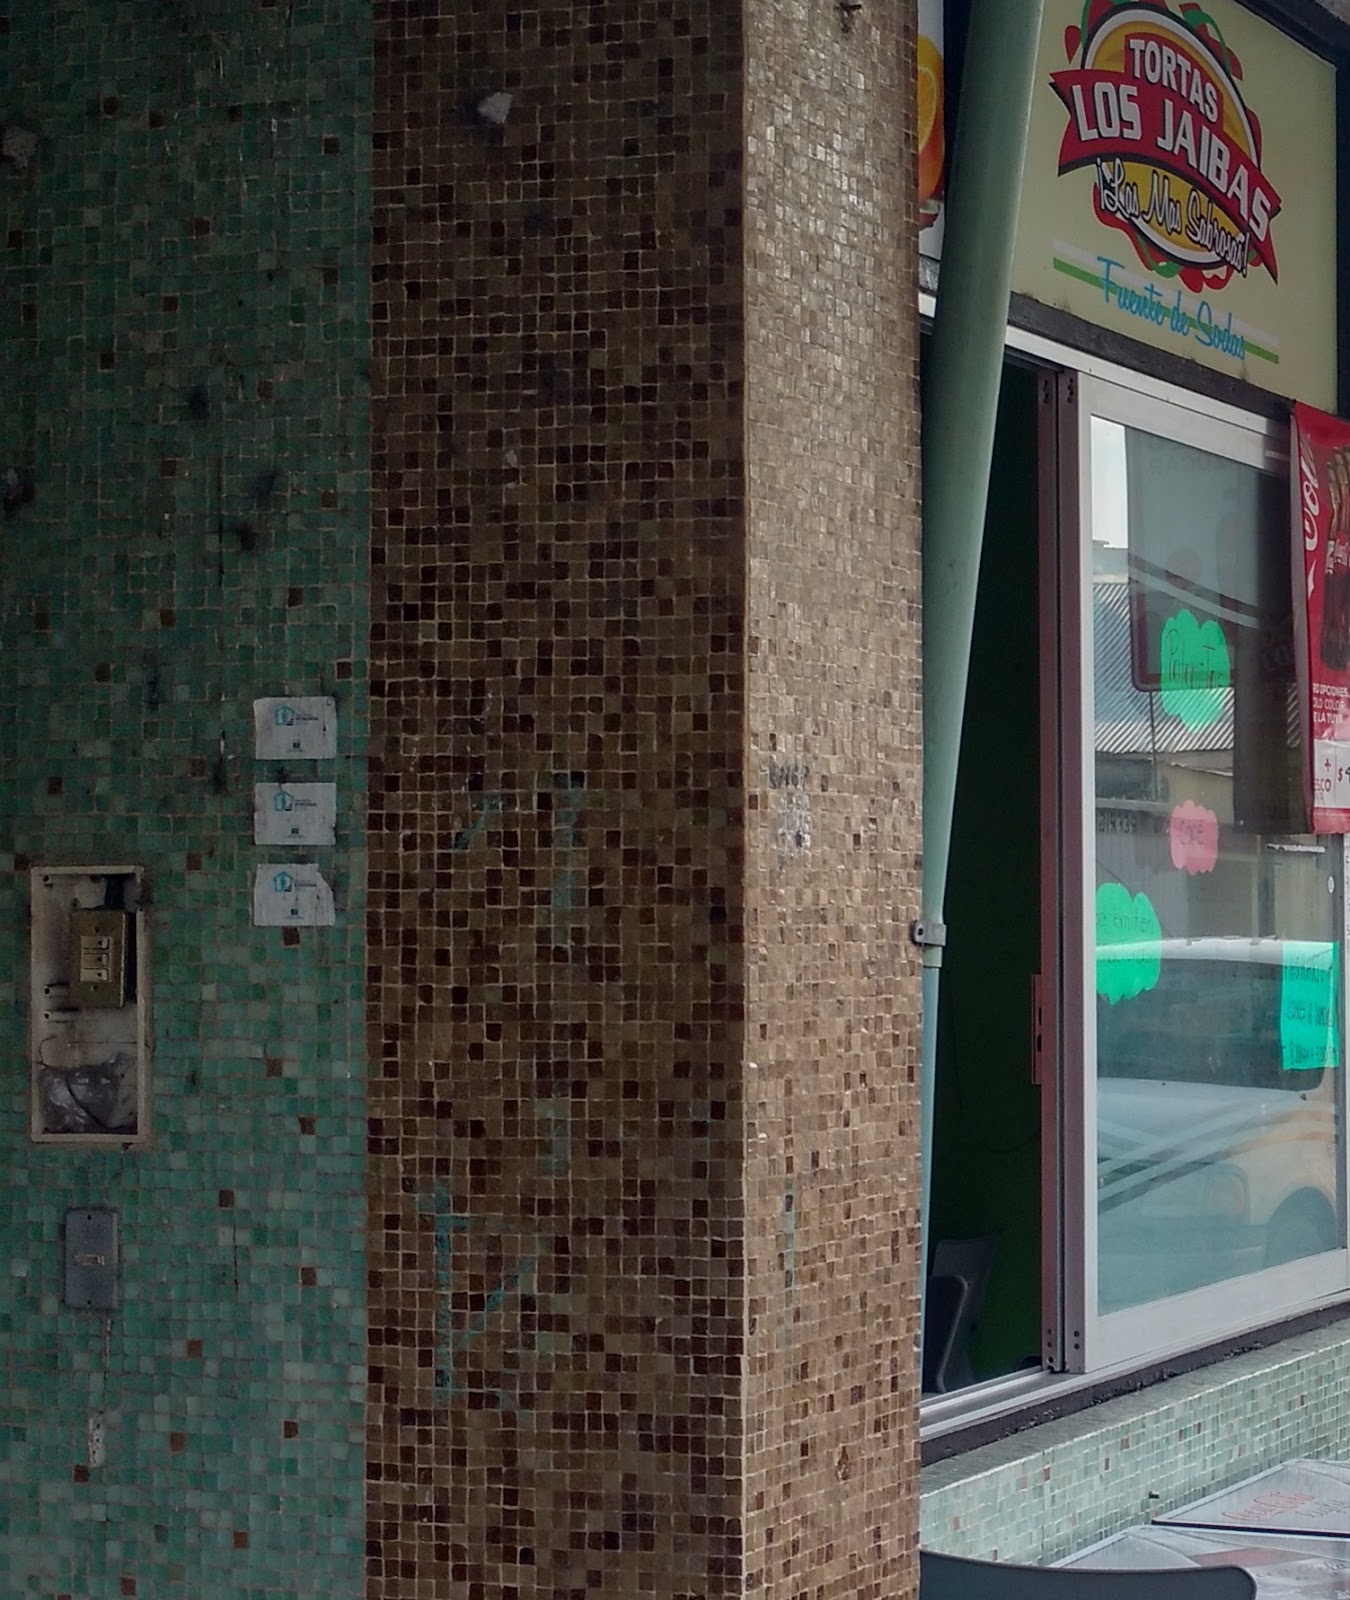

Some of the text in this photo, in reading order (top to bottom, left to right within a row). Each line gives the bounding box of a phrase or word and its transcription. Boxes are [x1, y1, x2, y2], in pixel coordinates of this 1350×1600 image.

[1129, 38, 1218, 123] TORTAS
[1070, 82, 1142, 142] LOS
[1157, 99, 1271, 243] JAIBAS
[1145, 172, 1183, 235] Mas
[1097, 256, 1245, 361] Fuente de Sodas
